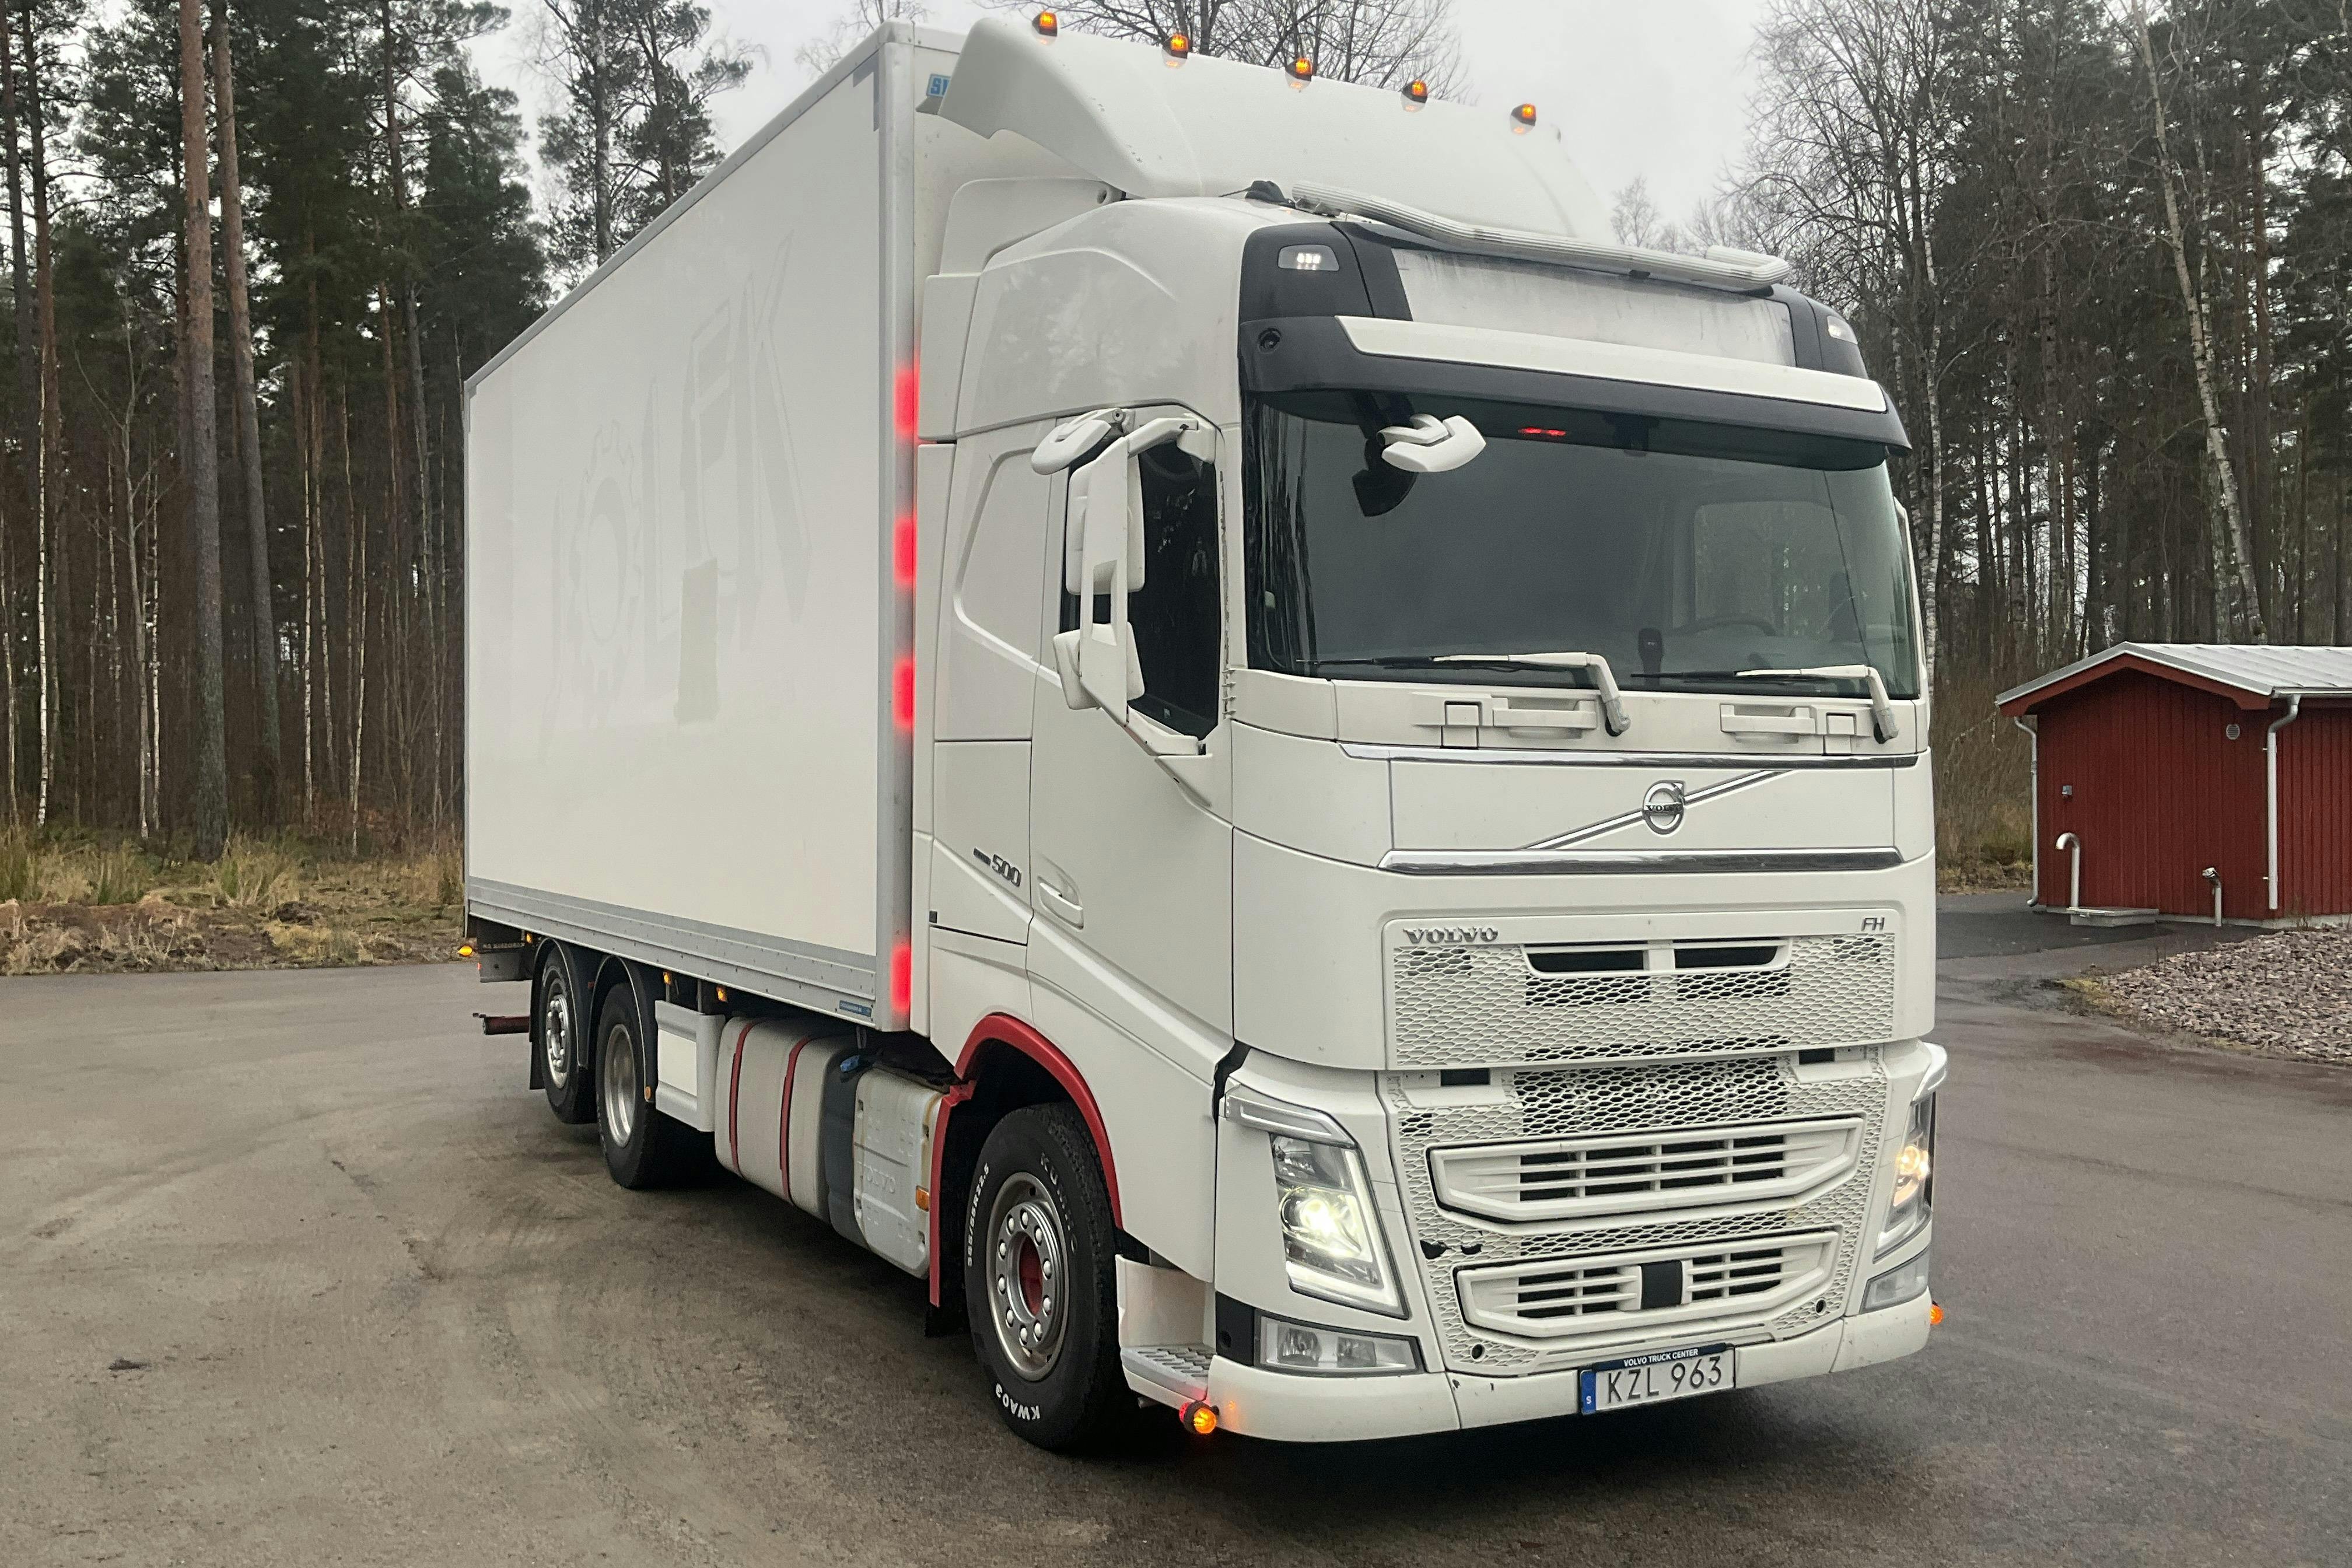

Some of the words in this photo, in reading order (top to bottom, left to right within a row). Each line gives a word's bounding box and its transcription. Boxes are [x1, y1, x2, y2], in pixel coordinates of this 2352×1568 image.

[992, 854, 1021, 887] 500
[1860, 917, 1885, 932] FH
[1402, 926, 1499, 944] VOLVO
[1623, 1357, 1647, 1367] VOLVO
[1648, 1352, 1671, 1363] TRUCK
[1672, 1348, 1699, 1359] CENTER
[1607, 1367, 1660, 1404] KZL
[1671, 1355, 1721, 1393] 963
[1586, 1395, 1592, 1405] S
